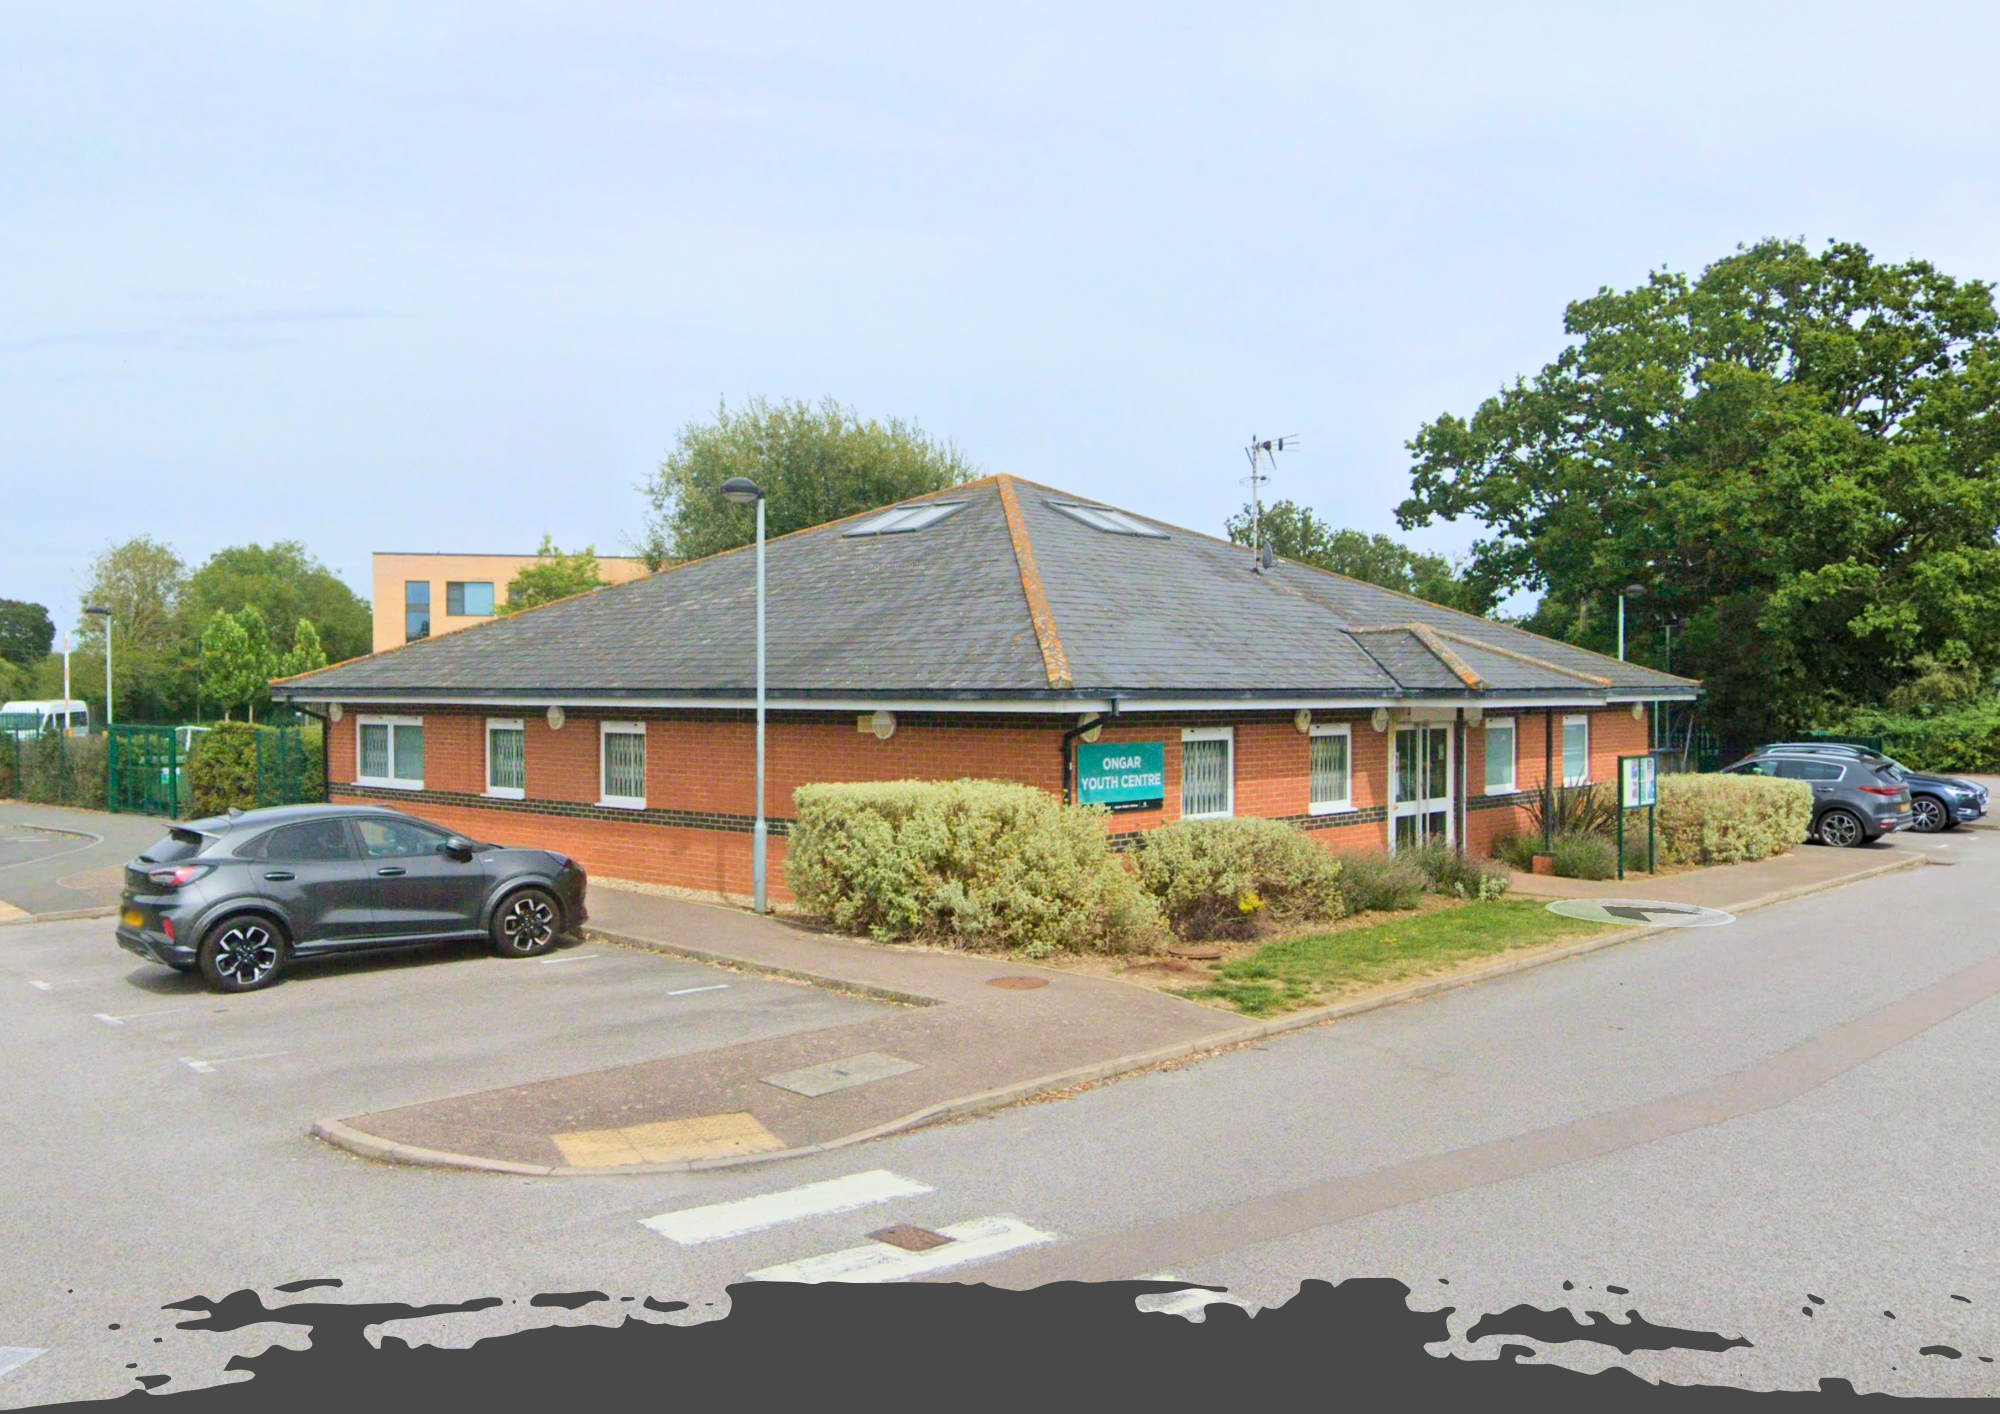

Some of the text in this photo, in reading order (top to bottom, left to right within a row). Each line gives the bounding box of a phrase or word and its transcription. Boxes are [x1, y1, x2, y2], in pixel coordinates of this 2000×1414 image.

[1103, 757, 1141, 770] ONGAR
[1082, 774, 1161, 790] YOUTH CENTRE
